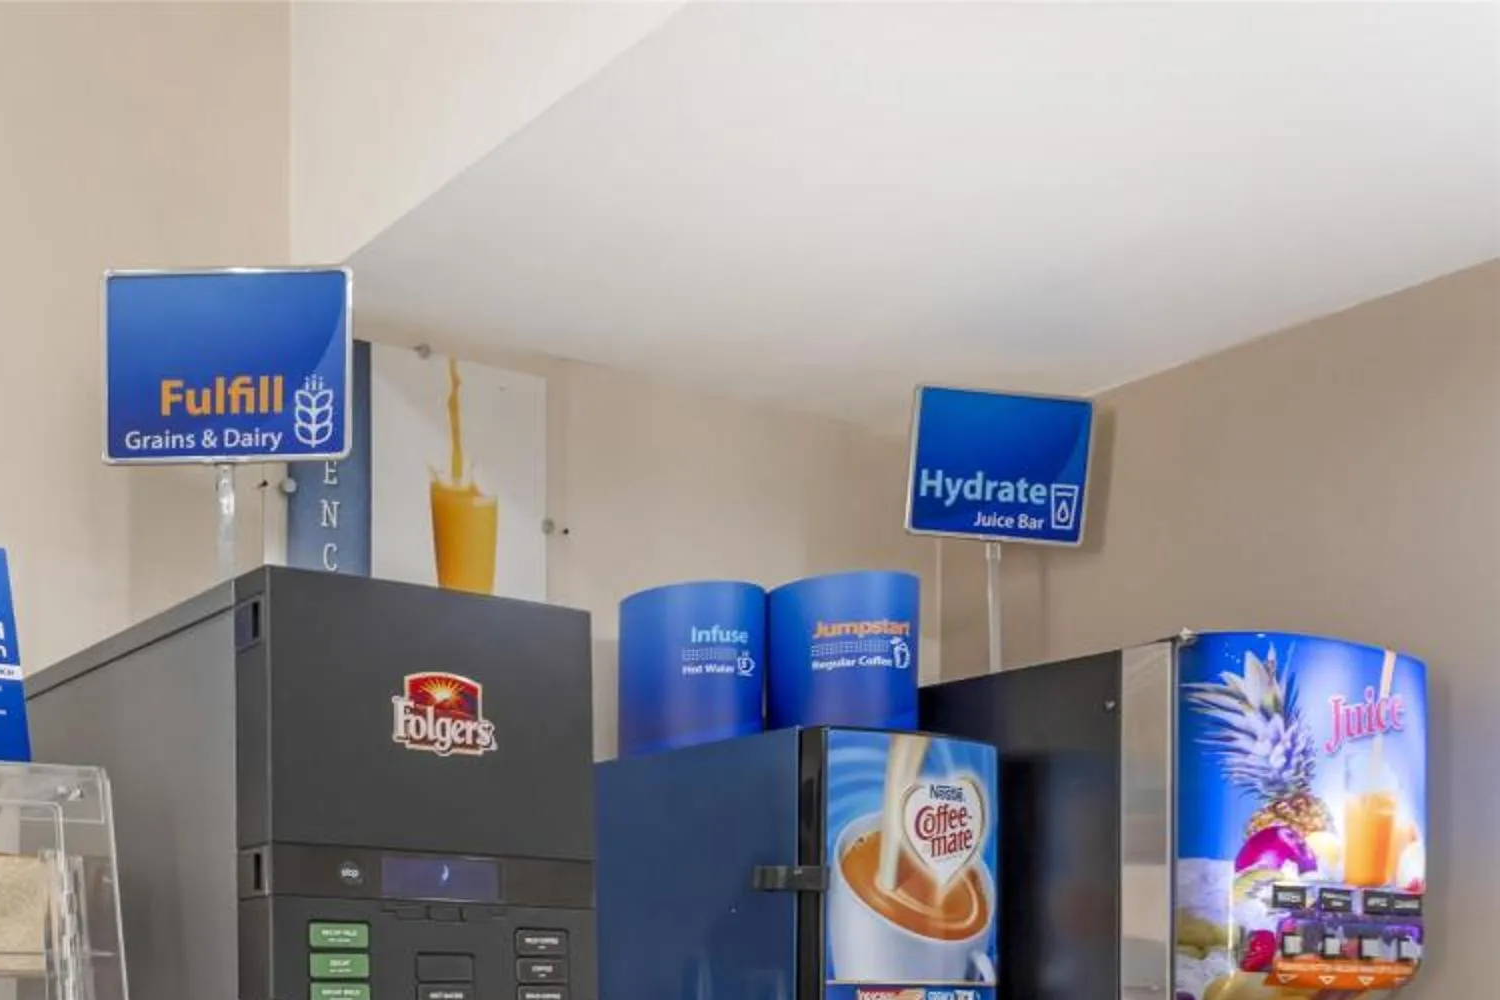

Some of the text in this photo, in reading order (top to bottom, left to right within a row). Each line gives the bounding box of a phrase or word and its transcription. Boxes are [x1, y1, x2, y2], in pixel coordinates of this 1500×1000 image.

[160, 374, 284, 416] Fulfill
[124, 427, 283, 452] Grains & Dairy
[918, 467, 1048, 508] Hydrate
[319, 460, 341, 572] ENC
[973, 511, 1045, 530] Juice Bar
[691, 624, 749, 644] Infuse
[811, 655, 893, 671] Regular Coffee
[391, 695, 497, 752] Folgers
[1324, 685, 1406, 753] Juice
[931, 829, 973, 858] mate
